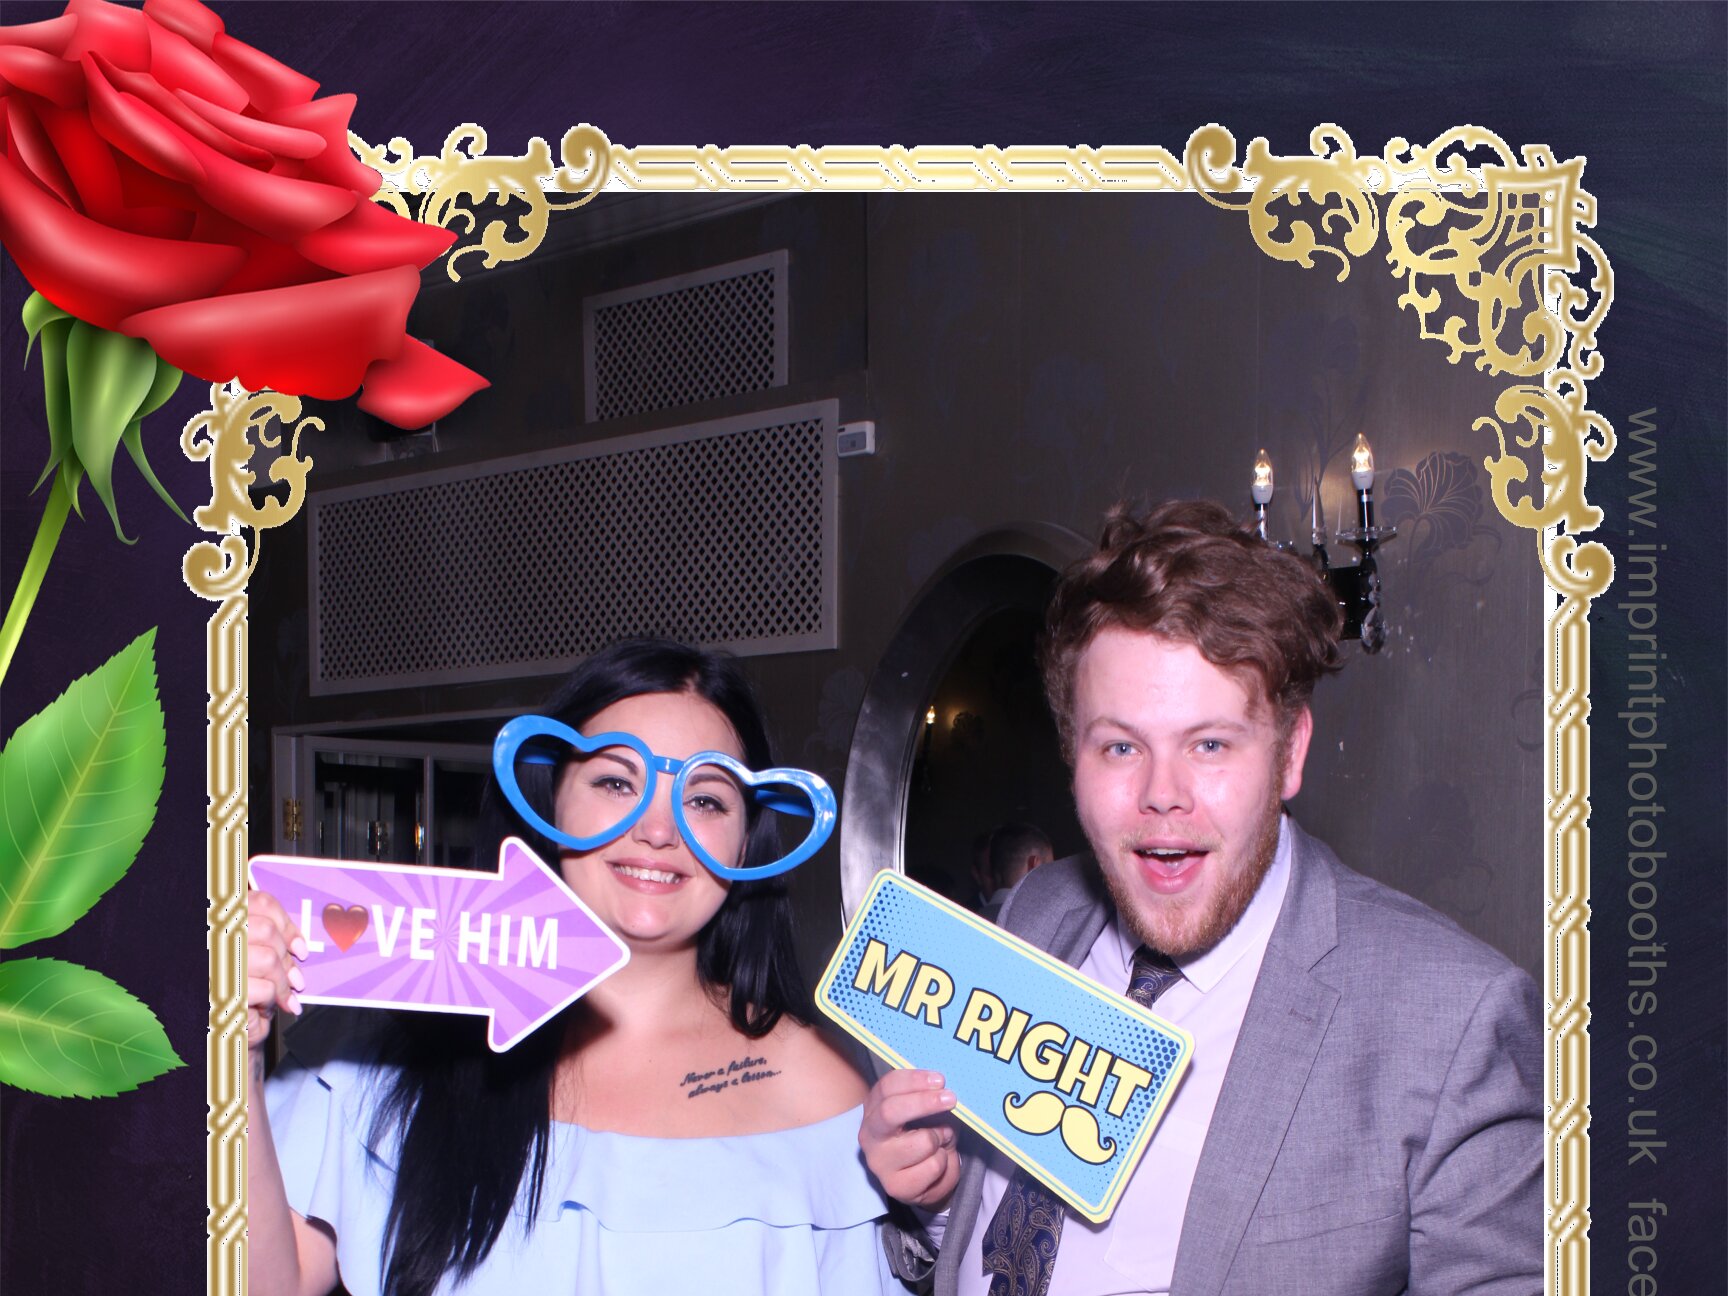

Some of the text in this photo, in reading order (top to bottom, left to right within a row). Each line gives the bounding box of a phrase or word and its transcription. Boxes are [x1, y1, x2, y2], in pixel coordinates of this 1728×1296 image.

[456, 910, 559, 970] HIM
[852, 937, 1154, 1119] MR RIGHT
